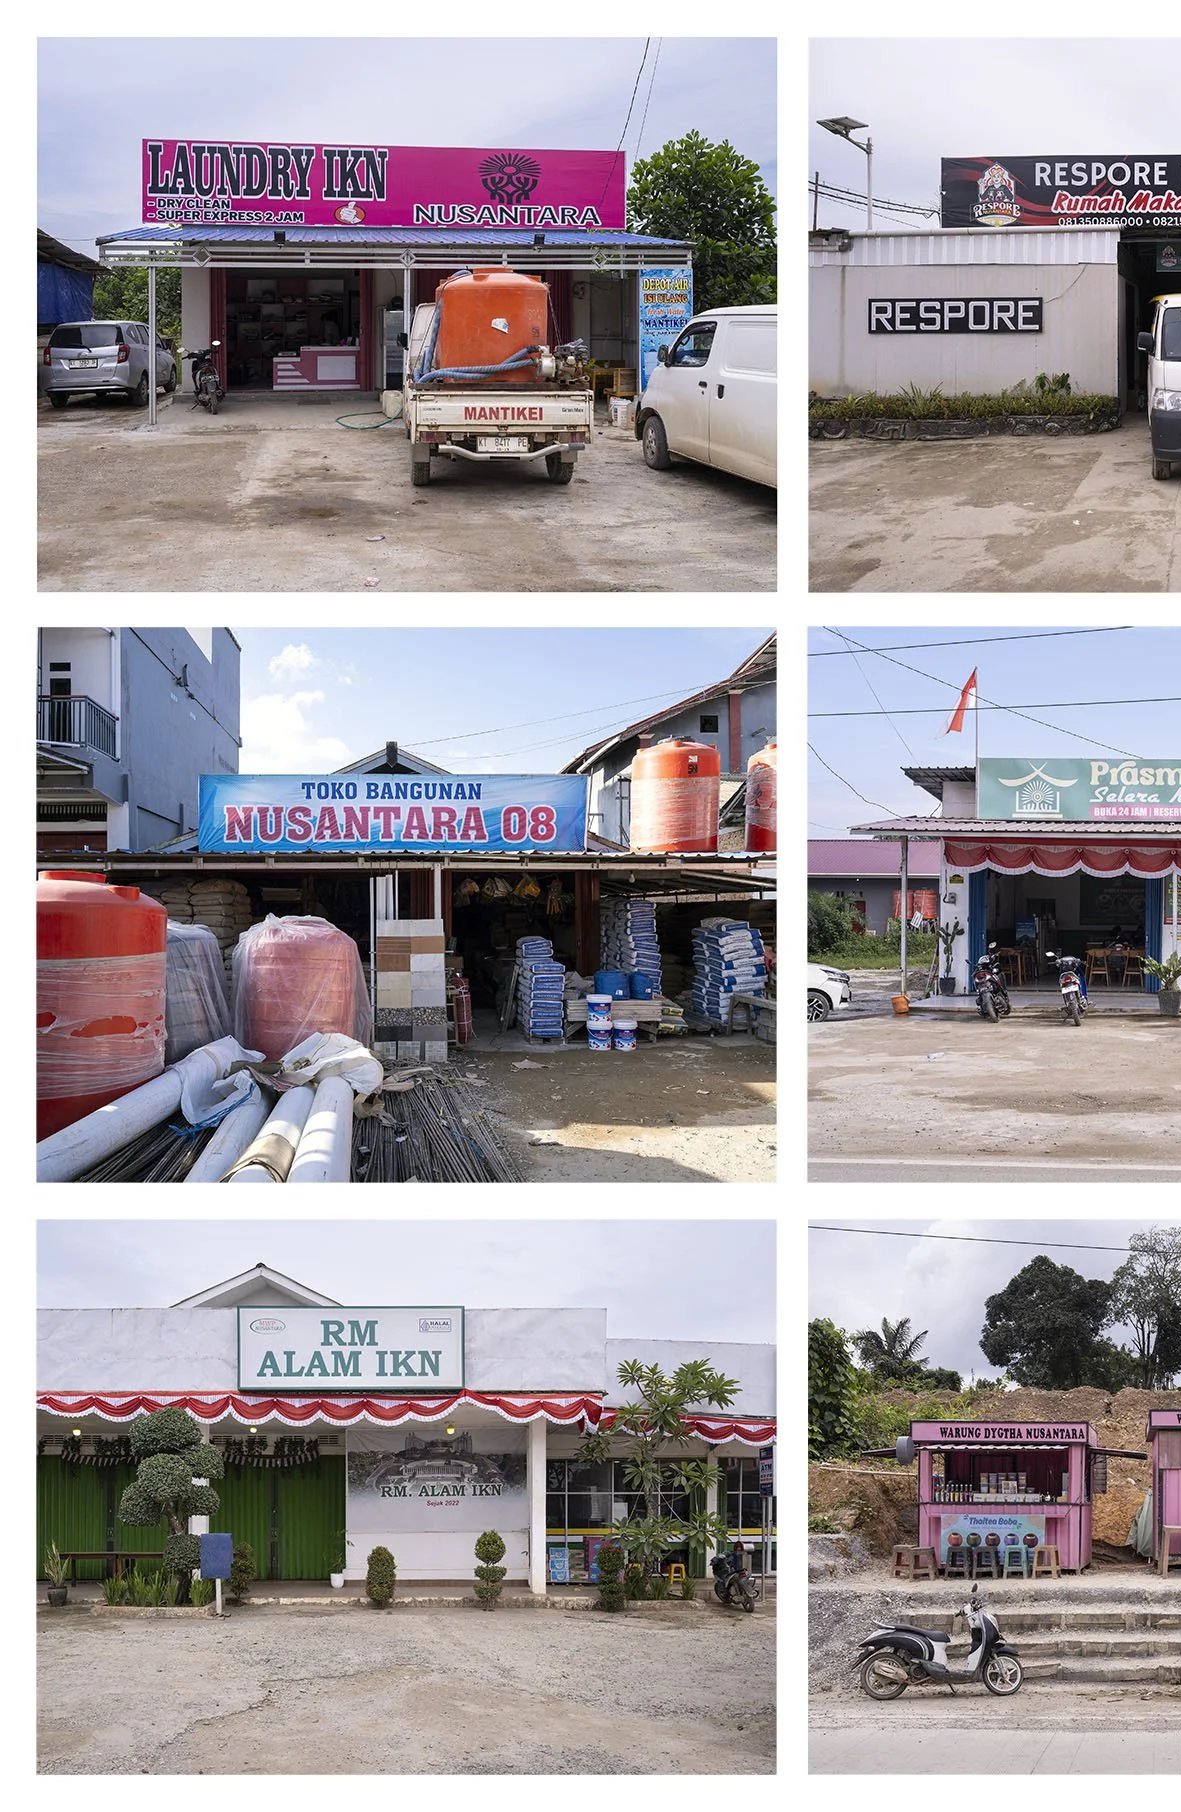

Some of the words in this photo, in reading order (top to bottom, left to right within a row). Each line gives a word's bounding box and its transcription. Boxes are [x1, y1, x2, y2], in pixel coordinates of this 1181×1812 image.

[148, 142, 315, 200] LAUNDRY
[323, 146, 388, 201] IKN
[1034, 161, 1168, 187] RESPORE
[157, 199, 184, 210] DRY
[186, 199, 231, 210] CLEAN
[972, 201, 1021, 218] RESPORE
[1051, 190, 1127, 214] Rumah
[157, 210, 200, 221] SUPER
[203, 211, 263, 222] EXPRESS
[264, 211, 273, 222] 2
[276, 212, 304, 223] JAM
[413, 204, 602, 226] NUSANTARA
[643, 278, 672, 290] DEPOT
[673, 278, 689, 290] AIR
[644, 293, 656, 304] ISI
[657, 293, 689, 304] ULANG
[871, 300, 1040, 331] RESPORE
[464, 406, 544, 421] MANTIKEI
[302, 781, 358, 800] TOKO
[366, 781, 482, 800] BANGUNAN
[1089, 786, 1161, 803] Selera
[1094, 807, 1118, 817] BUKA
[1118, 807, 1129, 817] 24
[1130, 807, 1148, 817] JAM
[223, 805, 489, 843] NUSANTARA
[500, 805, 557, 843] 08
[320, 1319, 379, 1346] RM
[256, 1350, 363, 1377] ALAM
[375, 1350, 443, 1377] IKN
[939, 1427, 982, 1439] WARUNG
[983, 1427, 1023, 1439] DYGTHA
[1026, 1427, 1085, 1440] NUSANTARA
[380, 1485, 412, 1498] RM.
[417, 1484, 466, 1497] ALAM
[471, 1483, 503, 1497] IKN
[968, 1517, 997, 1526] Thaitea
[998, 1517, 1018, 1526] Boba
